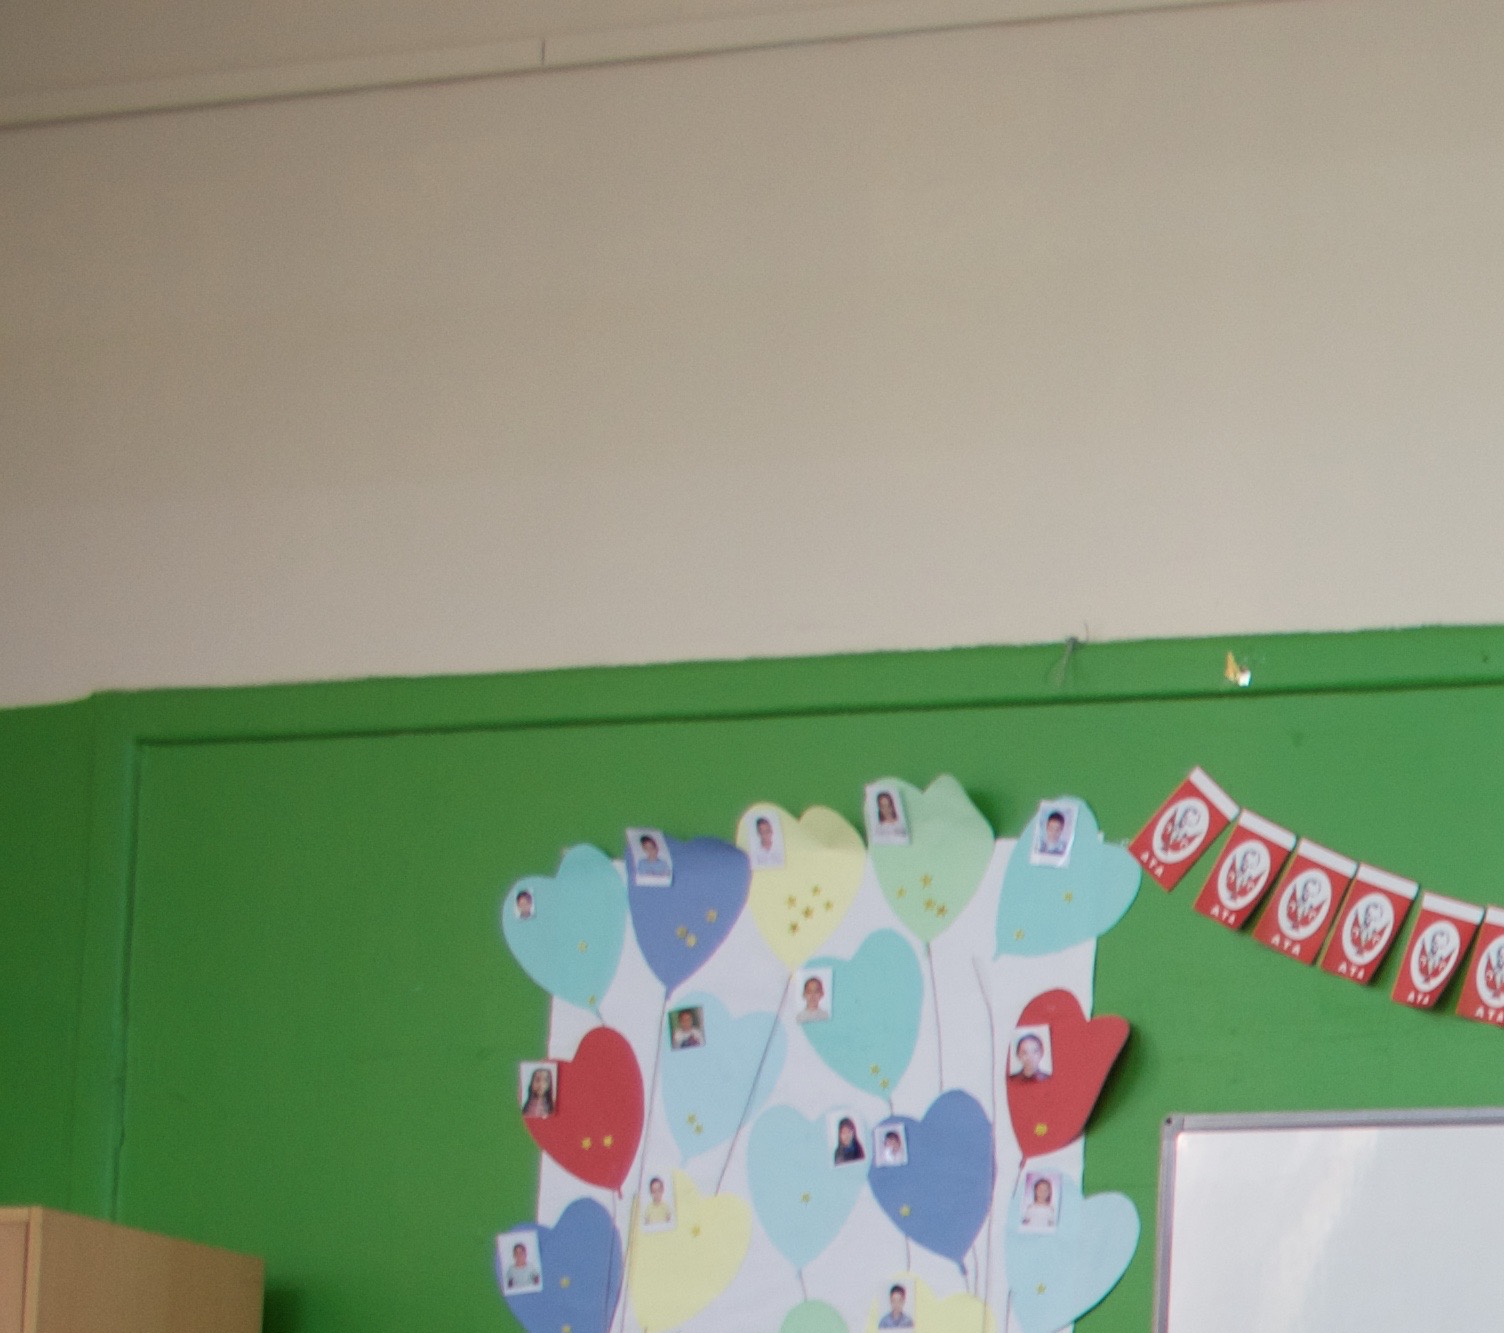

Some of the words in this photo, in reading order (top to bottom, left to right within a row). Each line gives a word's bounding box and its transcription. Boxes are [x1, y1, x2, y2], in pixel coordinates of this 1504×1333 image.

[1139, 852, 1164, 878] ATA
[1210, 905, 1236, 925] ATA
[1271, 934, 1301, 956] ATA
[1338, 962, 1364, 980] ATA
[1407, 990, 1429, 1006] ATA
[1475, 1006, 1504, 1023] ATA
